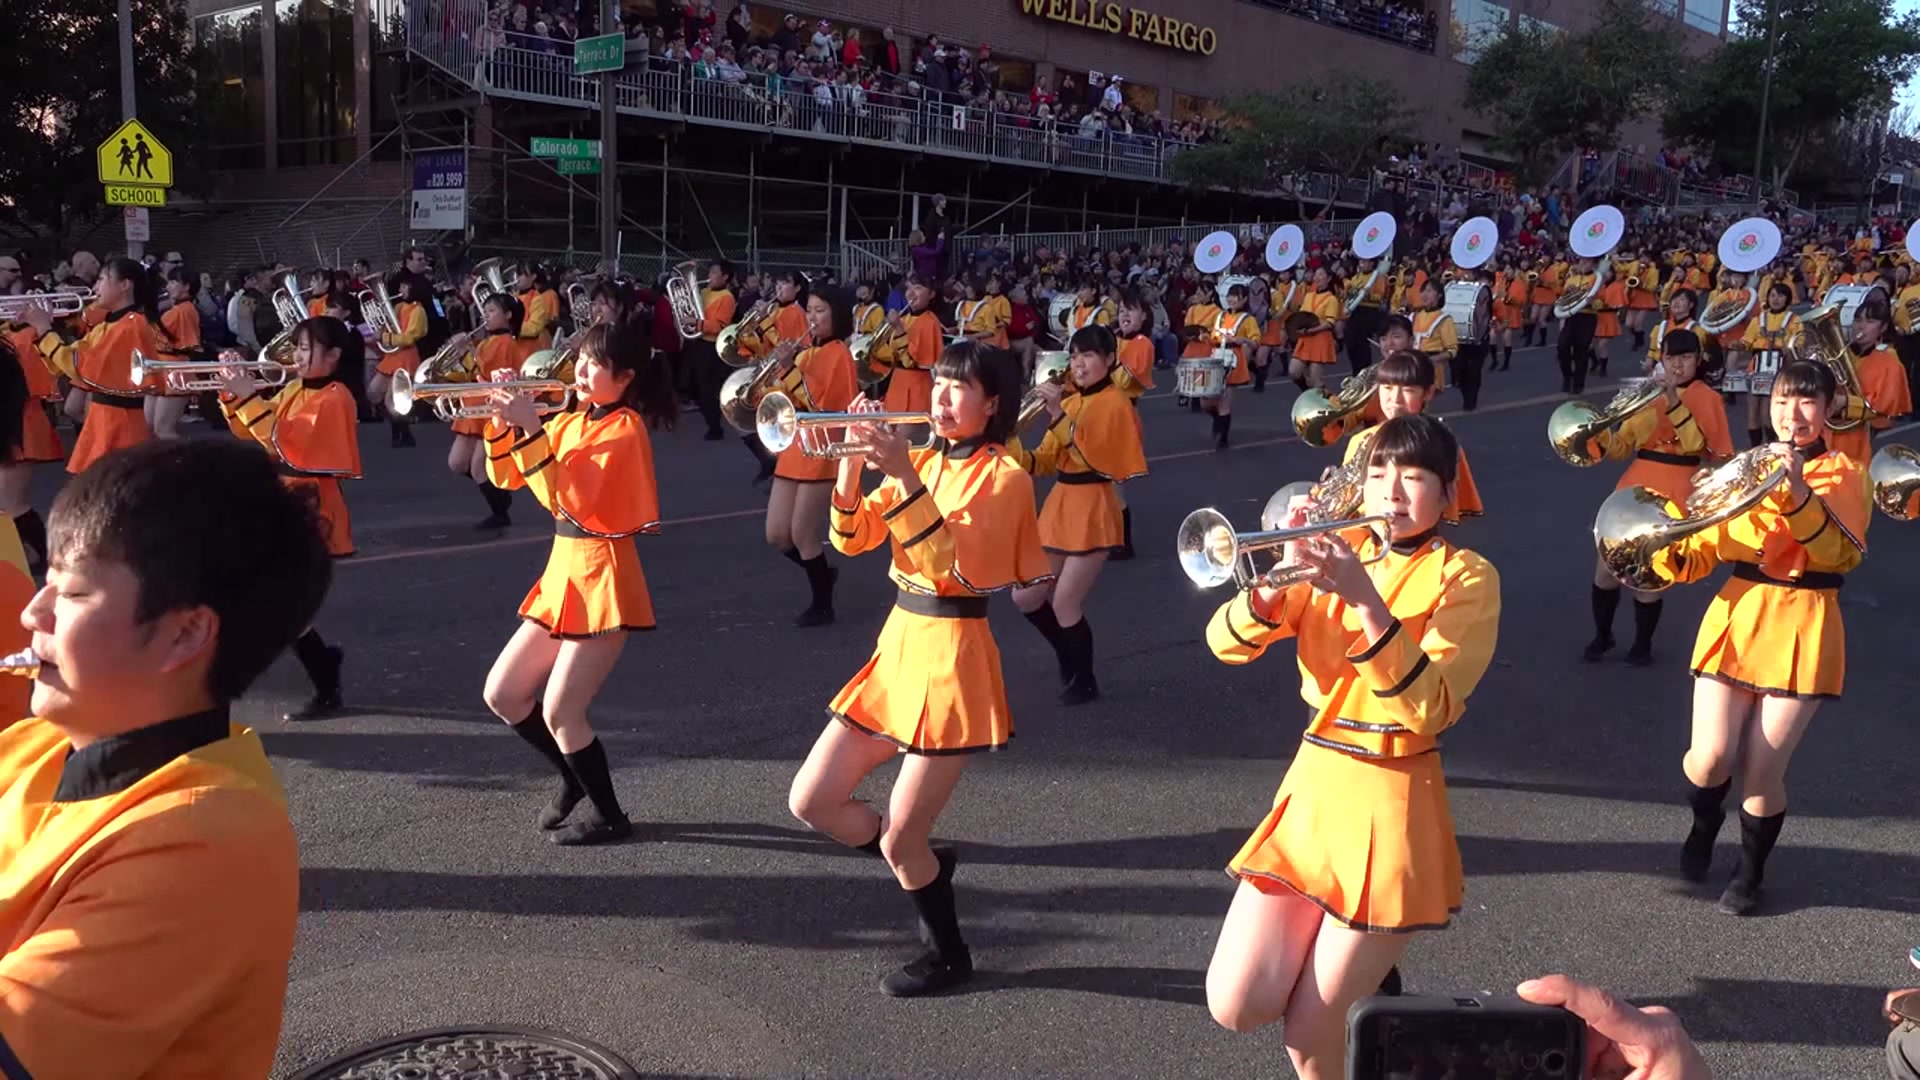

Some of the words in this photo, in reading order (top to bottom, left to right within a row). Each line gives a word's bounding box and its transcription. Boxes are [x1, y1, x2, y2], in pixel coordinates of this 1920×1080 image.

[1021, 0, 1121, 33] WELLS
[1128, 8, 1217, 55] FARGO
[579, 49, 607, 63] Terrace
[610, 45, 619, 60] Dr
[955, 112, 961, 128] 1
[533, 140, 579, 155] Colorado
[435, 155, 463, 167] LEASE
[560, 159, 592, 171] Terrace
[111, 188, 160, 203] SCHOOL
